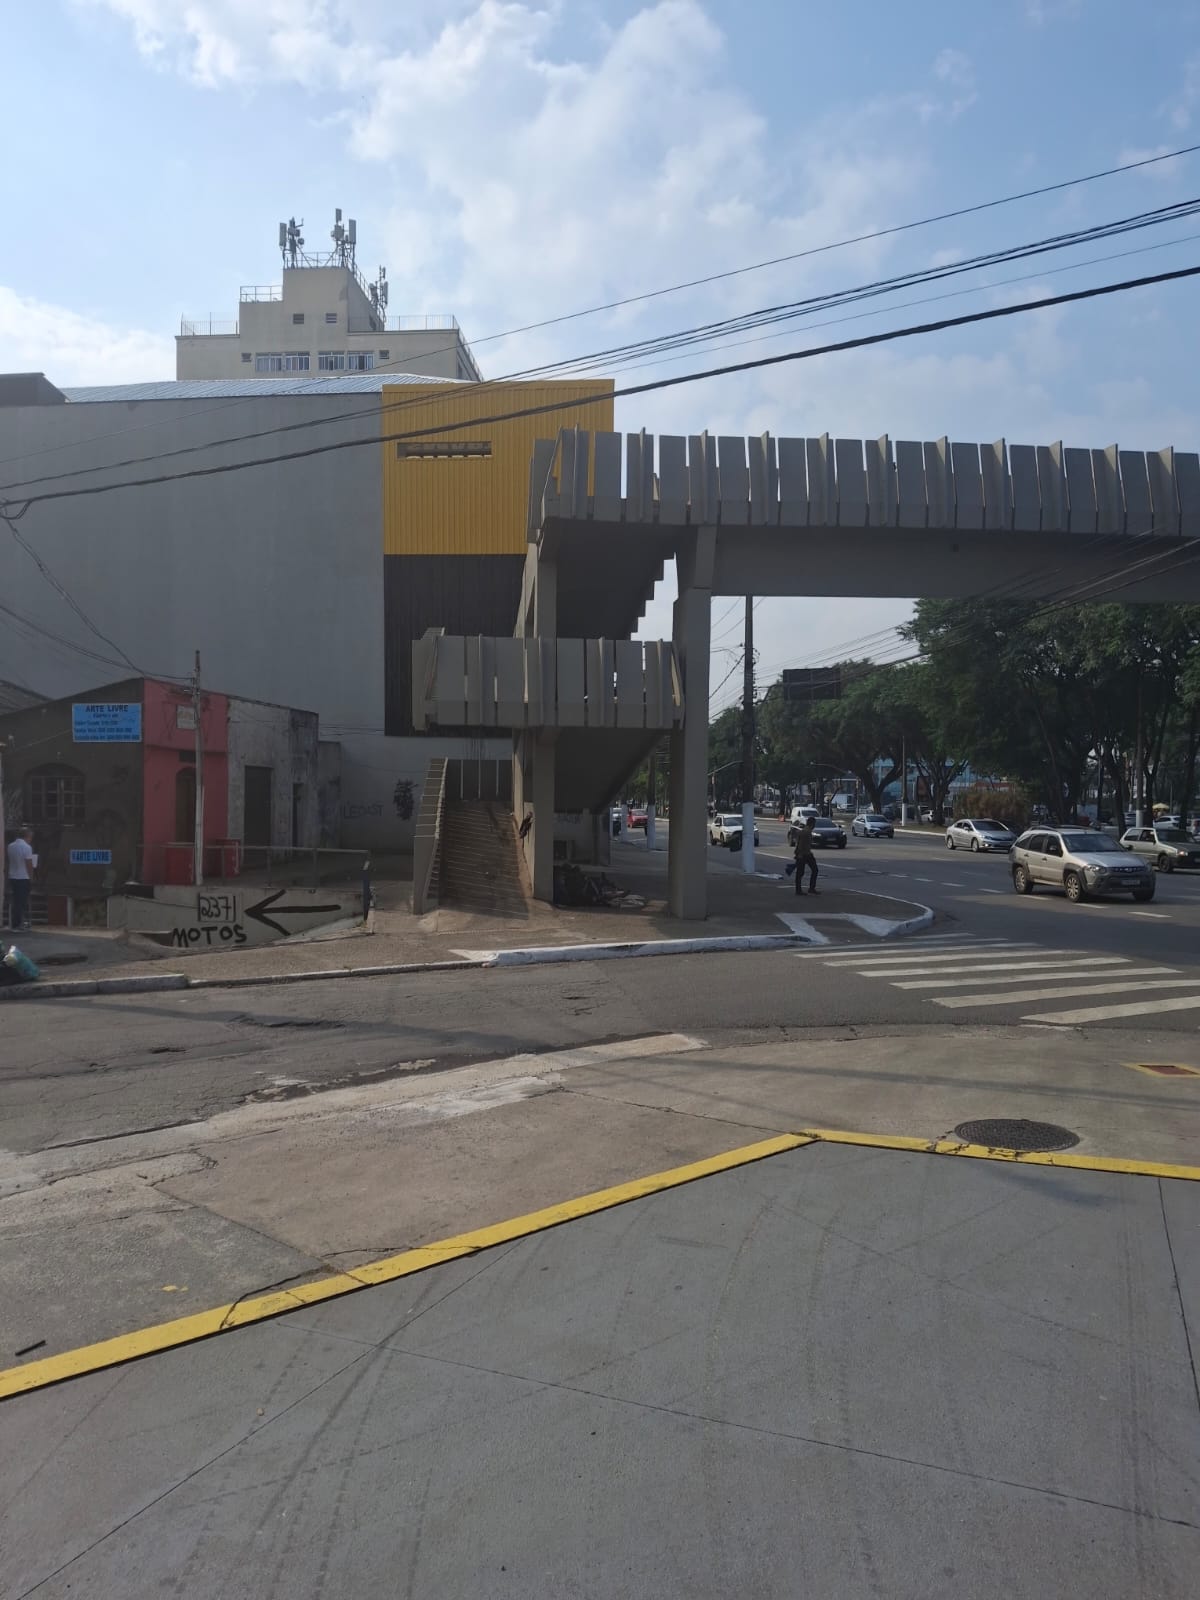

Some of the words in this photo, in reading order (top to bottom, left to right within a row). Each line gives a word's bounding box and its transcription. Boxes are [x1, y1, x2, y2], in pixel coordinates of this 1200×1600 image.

[85, 704, 105, 713] ARTE
[107, 704, 129, 713] LIVRE
[199, 895, 232, 921] 237
[171, 924, 247, 948] MOTOS
